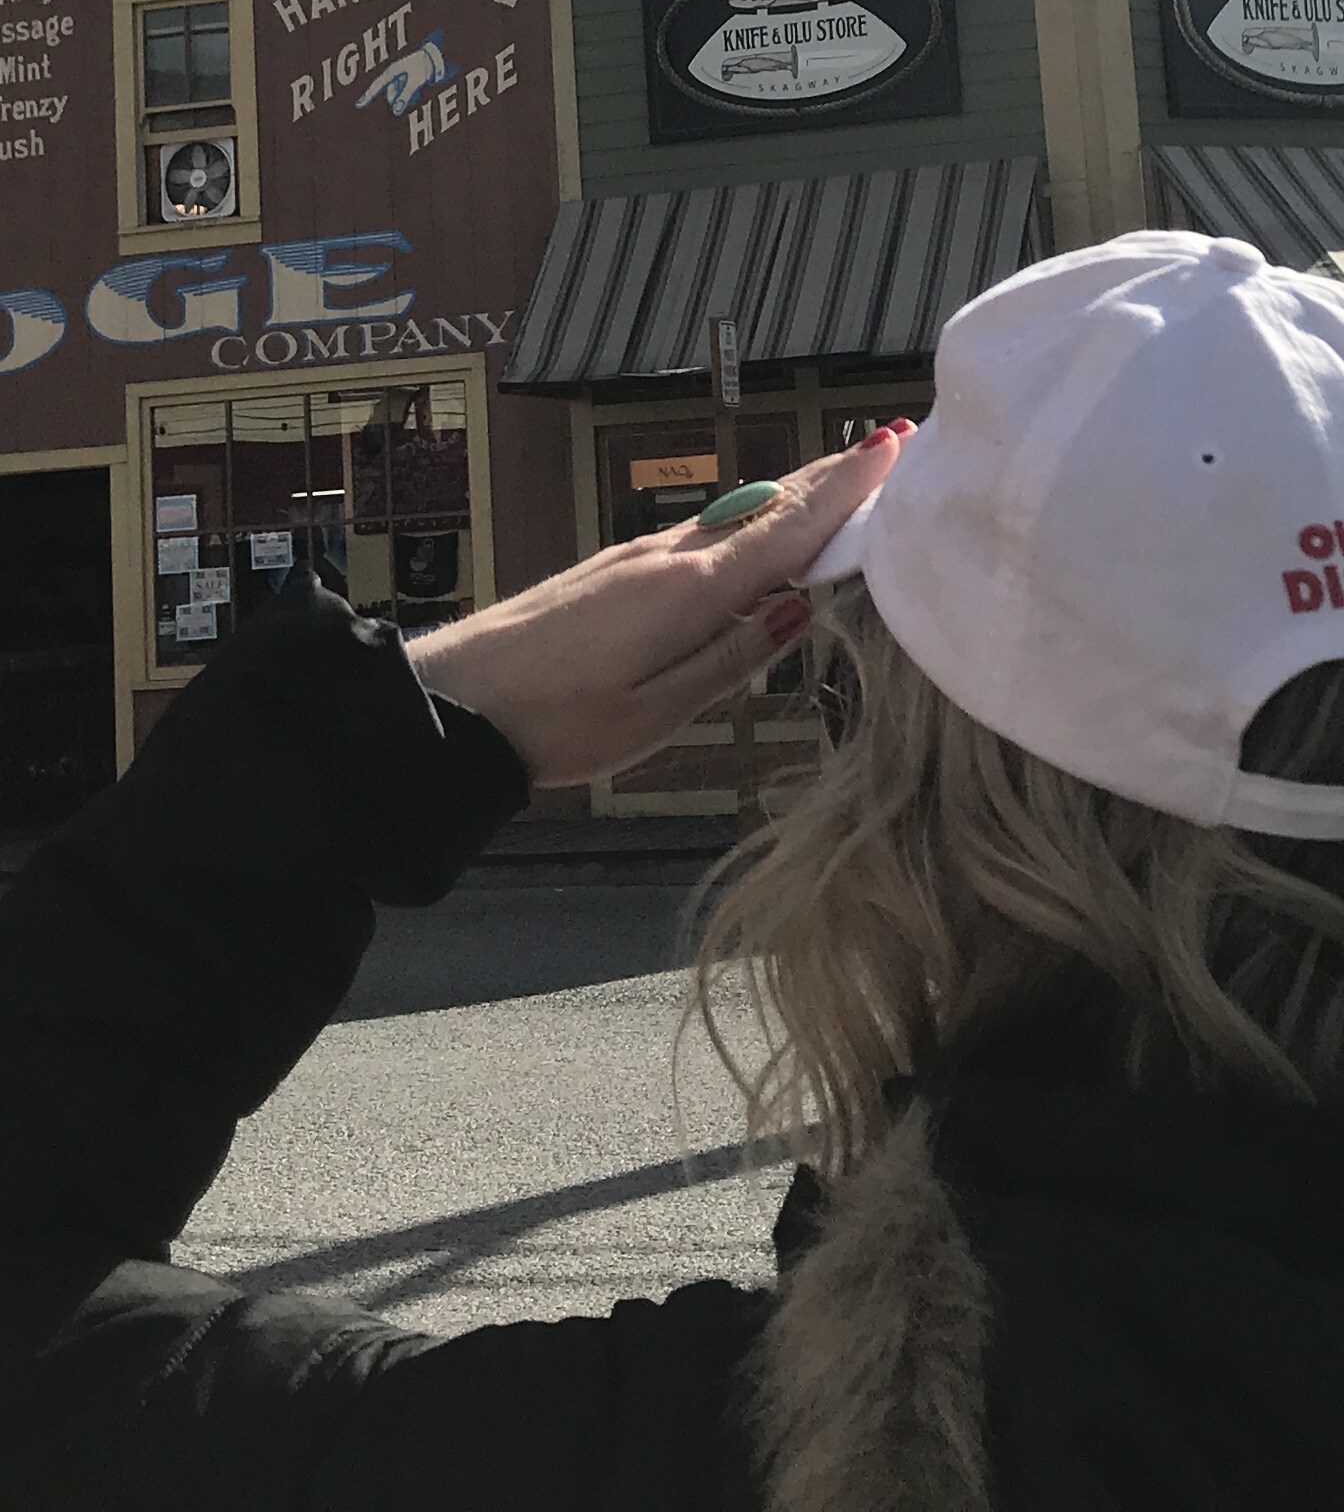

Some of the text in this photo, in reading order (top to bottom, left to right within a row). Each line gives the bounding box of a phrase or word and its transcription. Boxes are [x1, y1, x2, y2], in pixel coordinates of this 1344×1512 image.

[723, 15, 868, 51] KNIFE & ULU STORE
[1291, 0, 1301, 20] &
[290, 2, 412, 123] RIGHT
[758, 75, 841, 93] SKAGWAY
[408, 43, 518, 156] HERE
[211, 310, 515, 370] COMPANY
